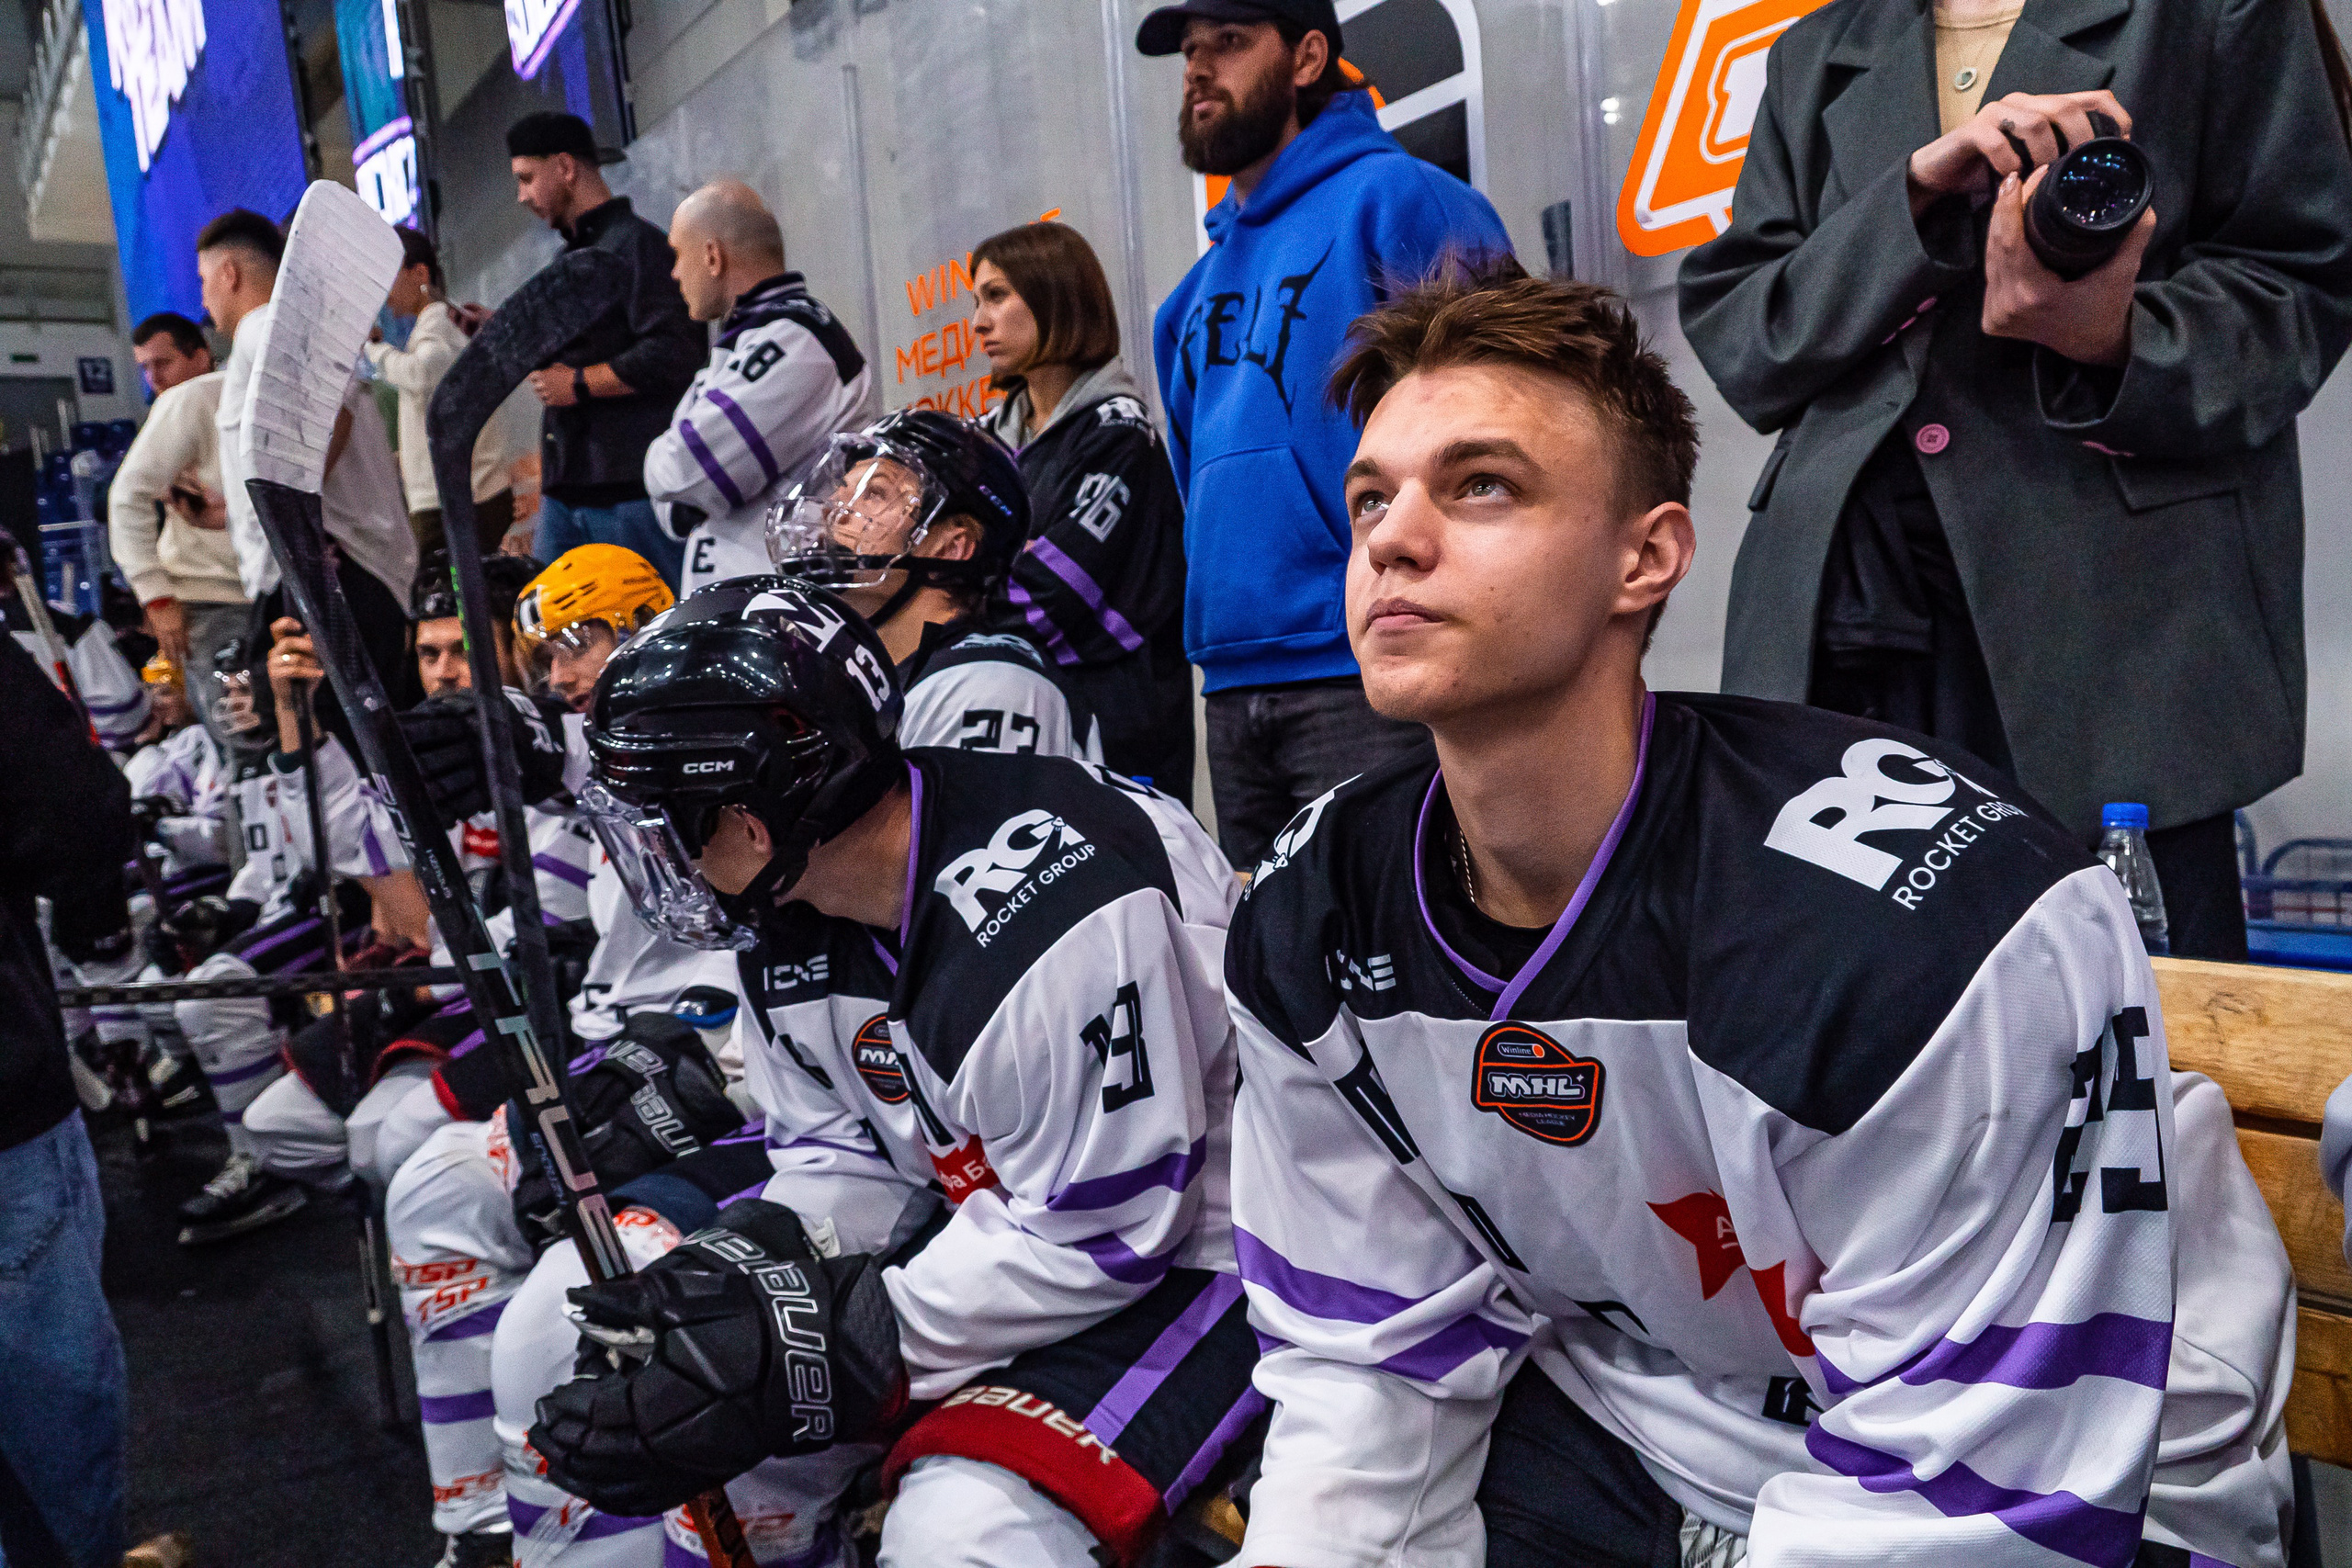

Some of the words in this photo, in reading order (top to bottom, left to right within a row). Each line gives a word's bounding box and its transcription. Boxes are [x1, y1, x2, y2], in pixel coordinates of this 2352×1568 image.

[906, 251, 974, 316] WIN
[896, 318, 986, 384] МЕДИ
[845, 644, 890, 713] 13
[683, 761, 735, 774] CCM
[976, 880, 1038, 948] ROCKET
[1038, 844, 1096, 895] GROUP
[1892, 816, 1985, 911] ROCKET
[1080, 980, 1155, 1113] 13
[467, 905, 634, 1280] TRUE
[1491, 1076, 1580, 1096] MHL
